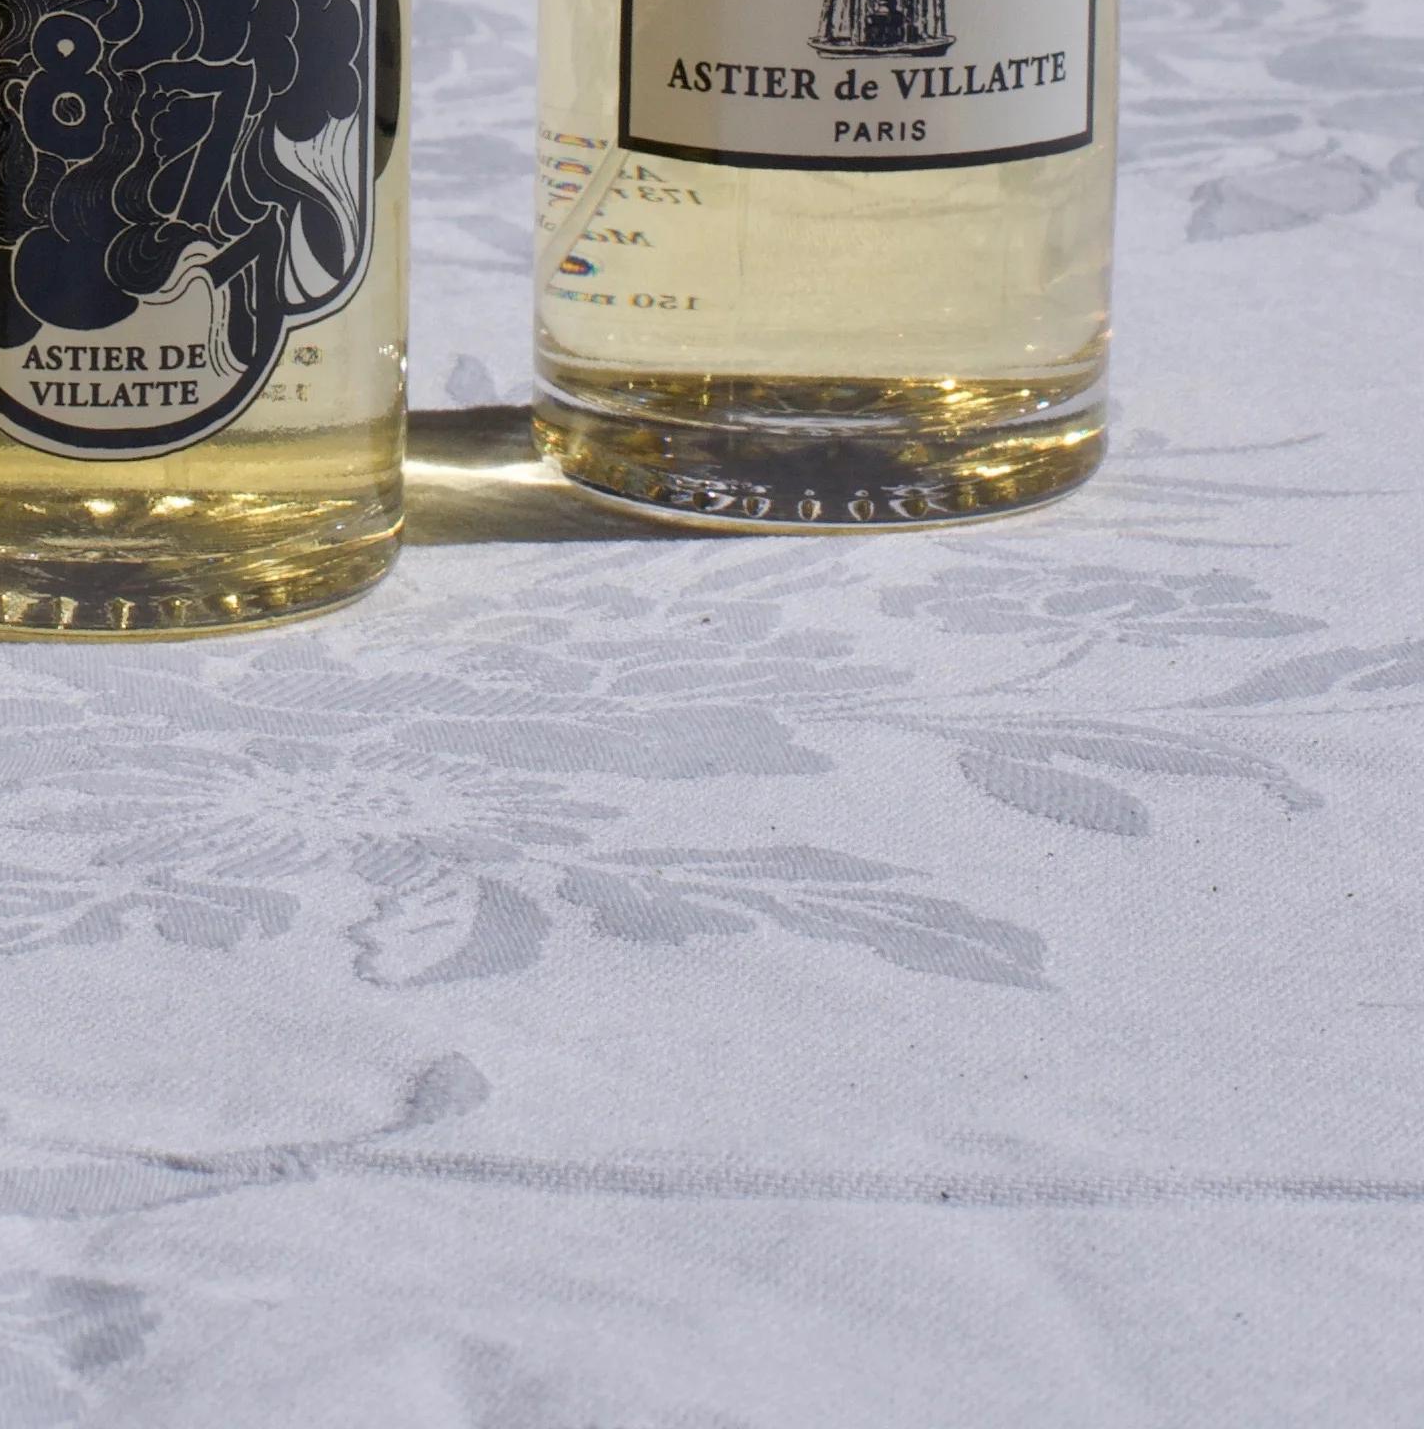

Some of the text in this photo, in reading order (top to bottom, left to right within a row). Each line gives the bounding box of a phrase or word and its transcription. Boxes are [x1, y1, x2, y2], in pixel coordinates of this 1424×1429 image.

[667, 51, 1067, 101] ASTIER de VILLATTE
[834, 119, 926, 143] PARIS
[22, 343, 207, 372] ASTIER DE
[29, 380, 199, 408] VILLATTE
